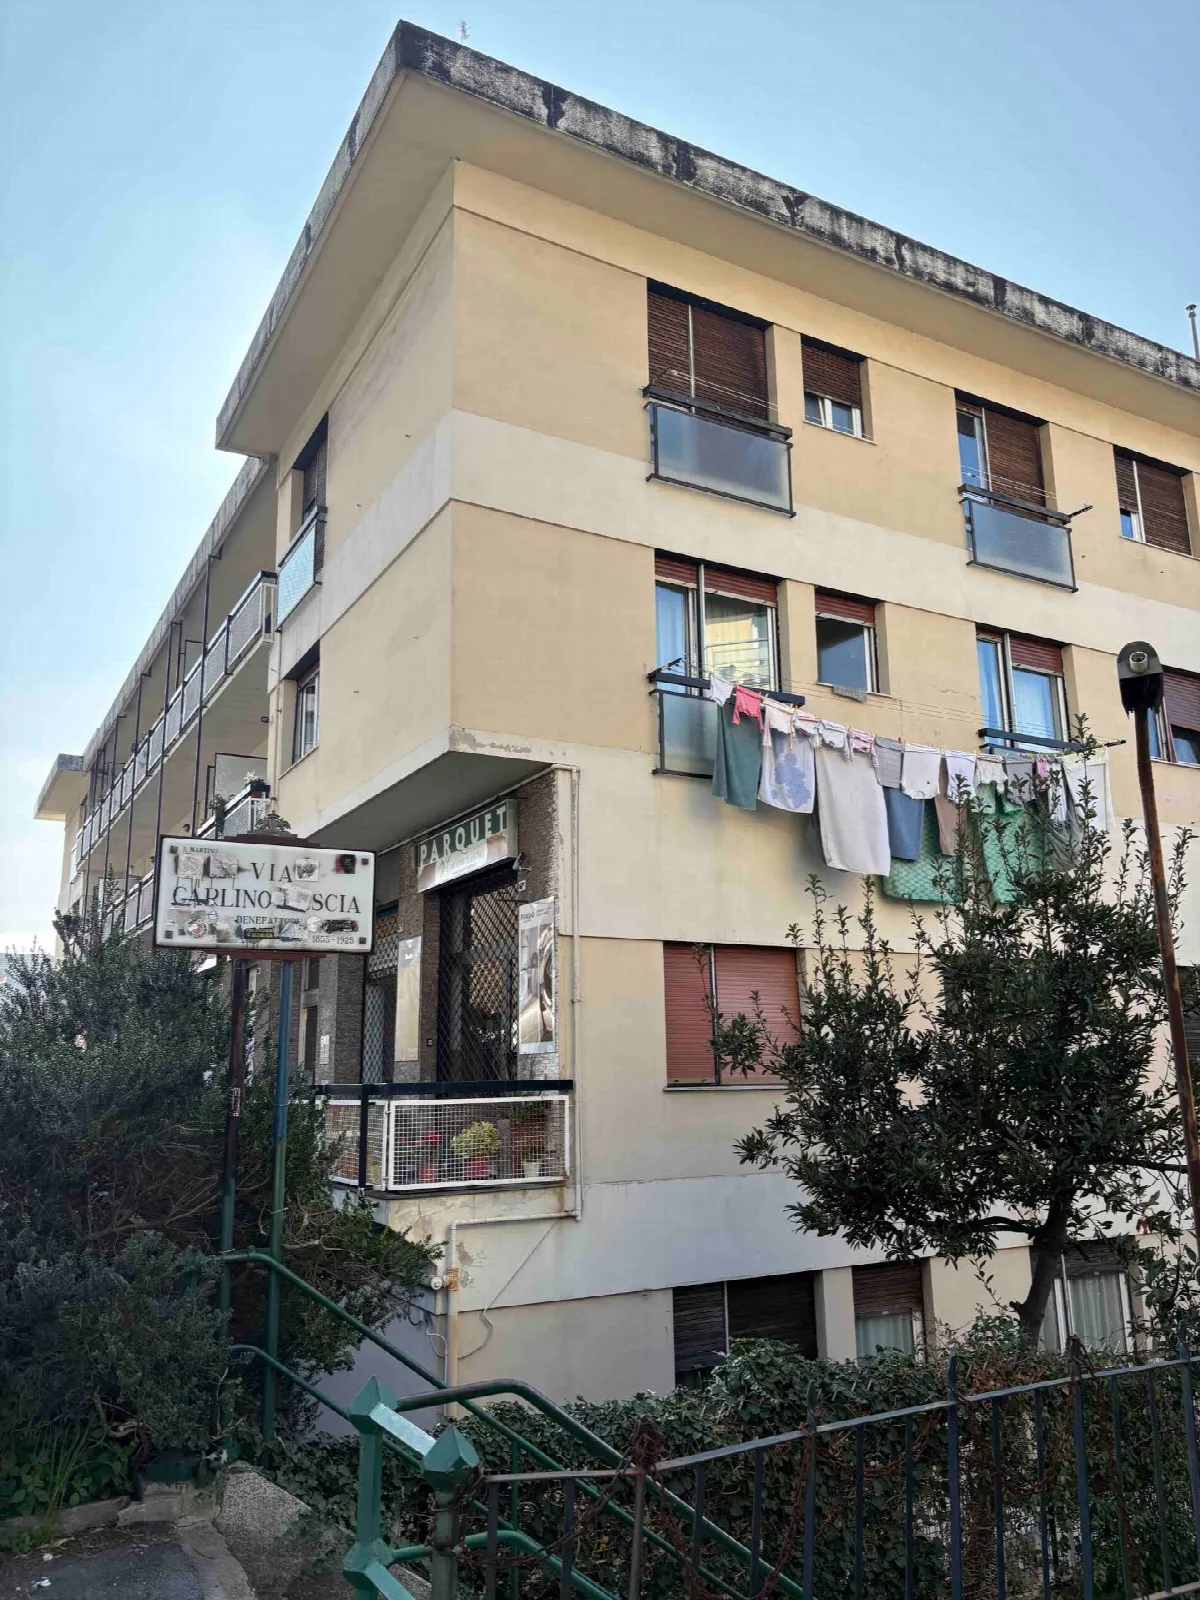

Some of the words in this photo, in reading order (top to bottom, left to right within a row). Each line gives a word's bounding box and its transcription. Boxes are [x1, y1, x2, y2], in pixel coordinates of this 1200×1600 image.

[419, 805, 506, 867] PARQUET
[190, 847, 219, 855] MARTINO
[250, 862, 293, 883] VIA
[173, 886, 272, 909] CARLINO
